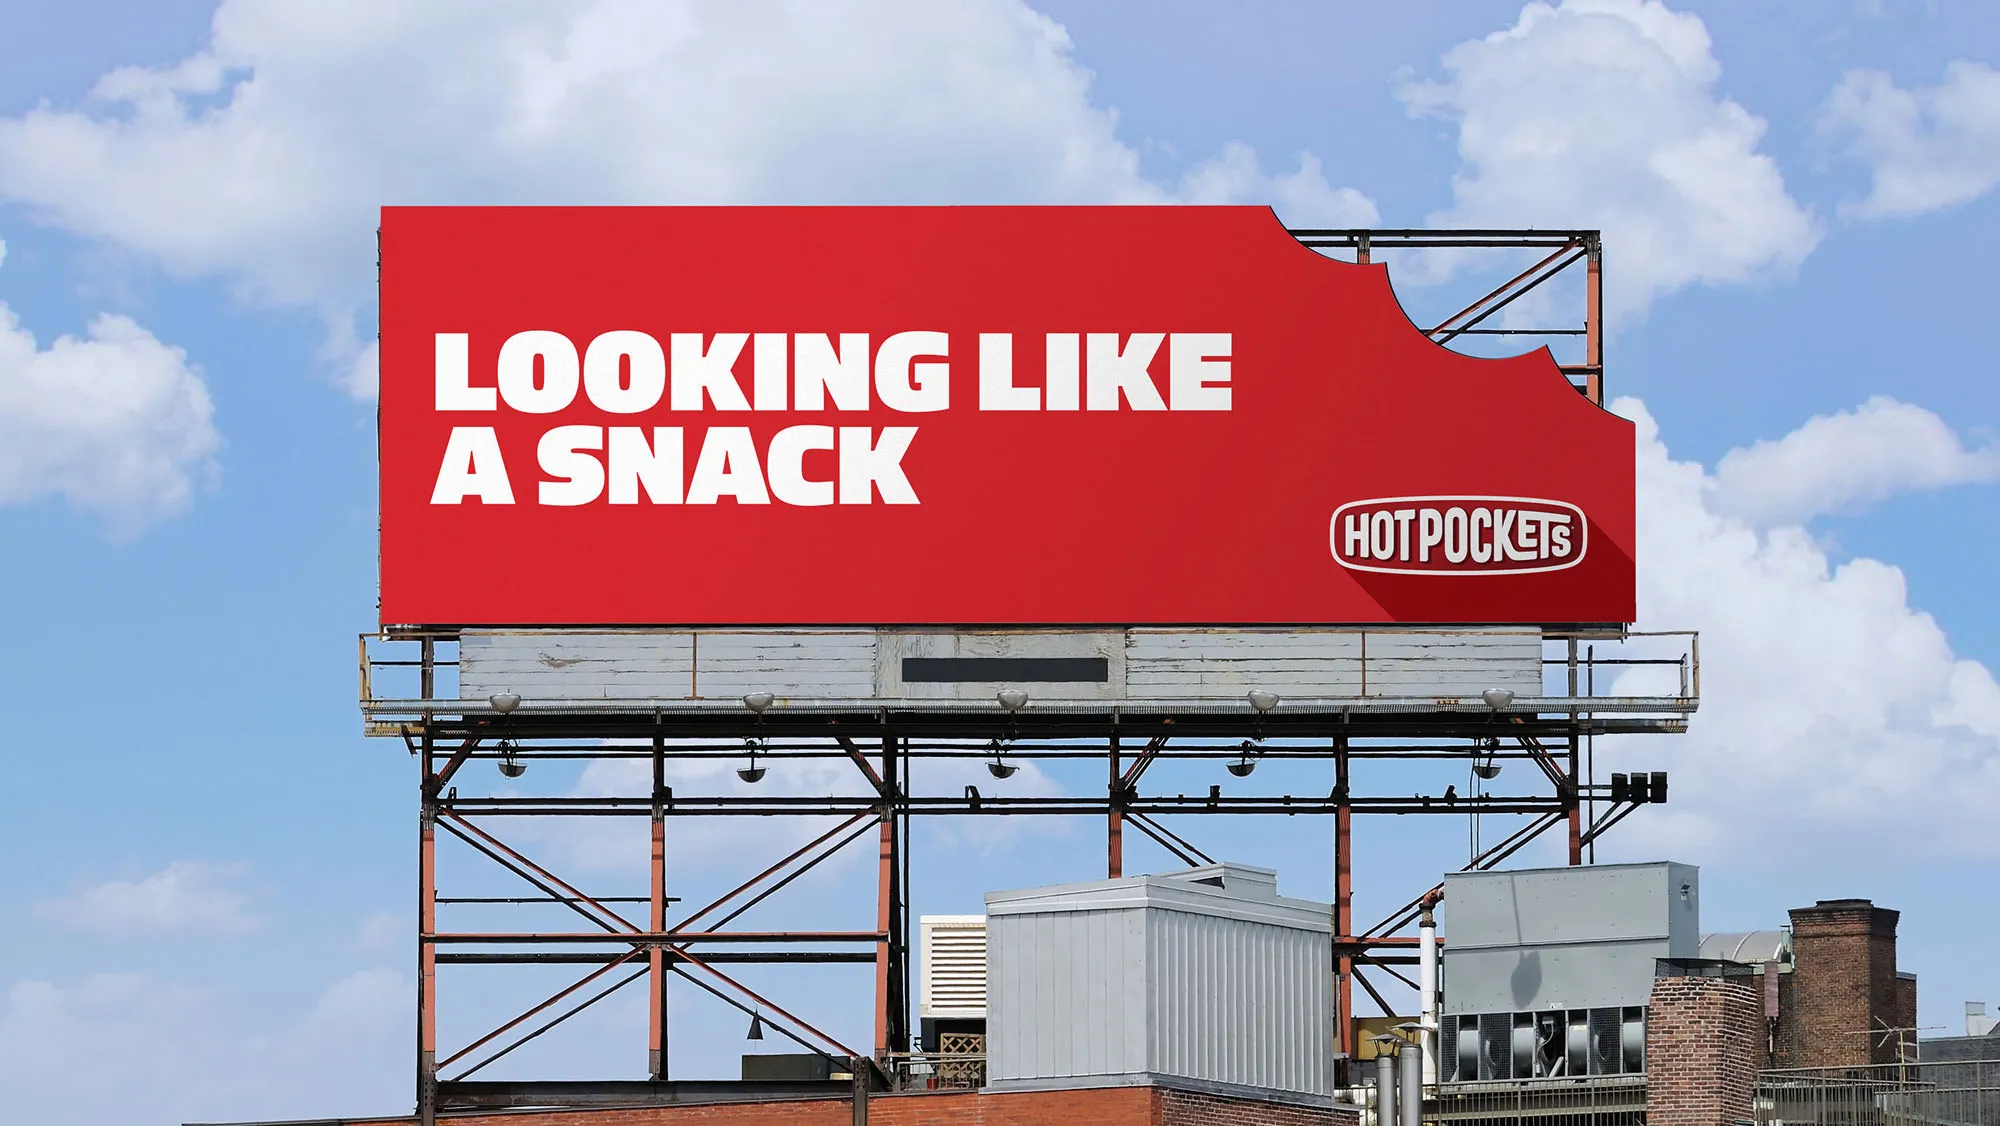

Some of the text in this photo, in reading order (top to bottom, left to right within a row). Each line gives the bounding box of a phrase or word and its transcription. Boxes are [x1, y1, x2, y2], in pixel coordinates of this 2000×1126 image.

[434, 330, 1234, 414] LOOKING LIKE
[430, 424, 920, 507] A SNACK
[1345, 509, 1416, 562] HOT
